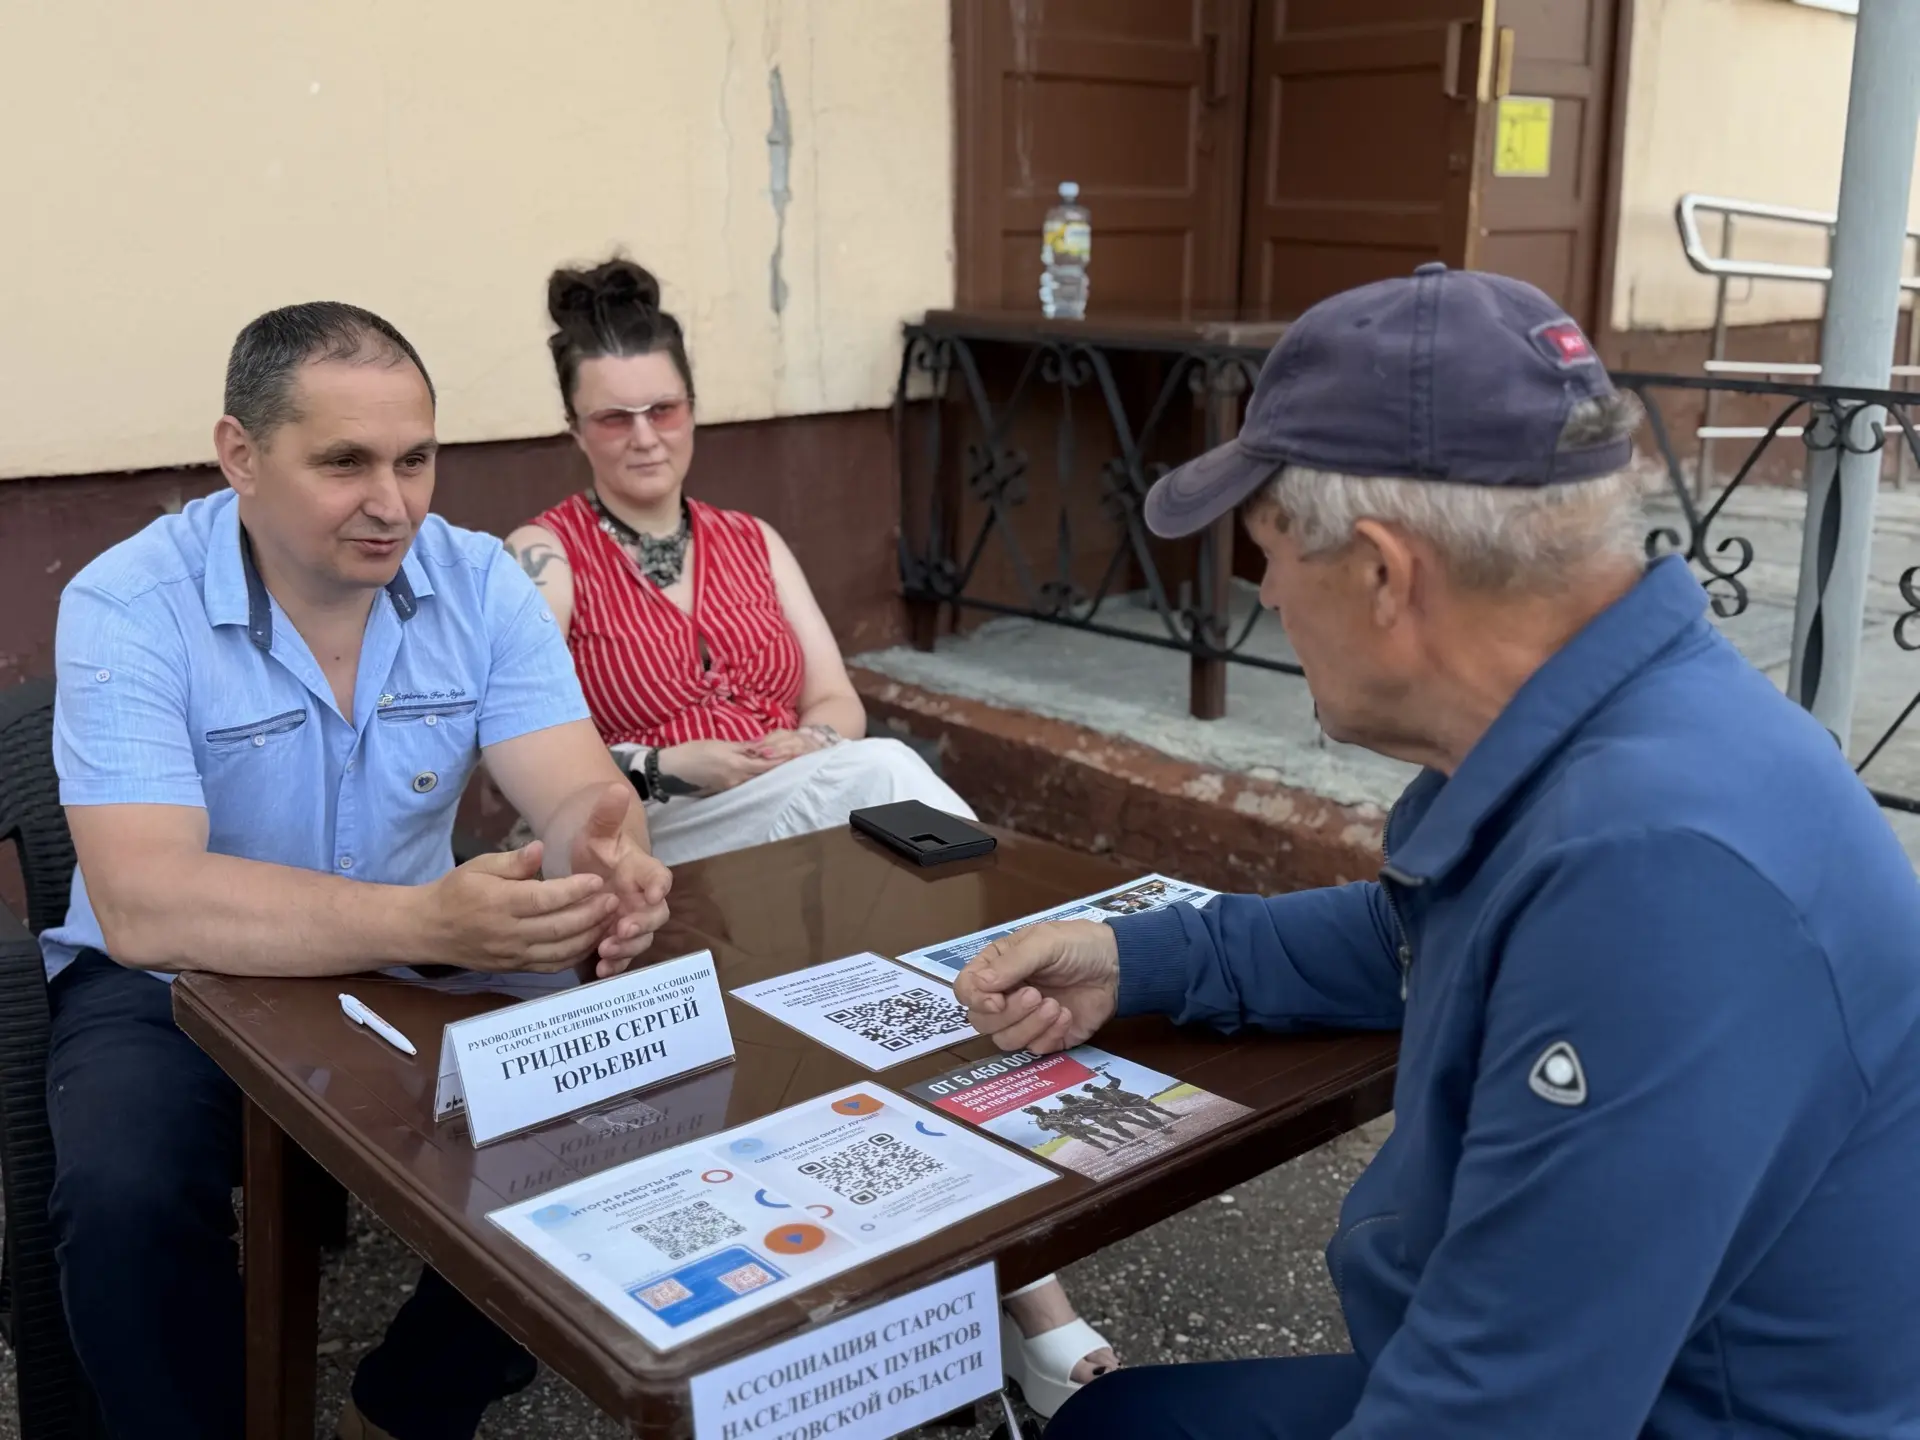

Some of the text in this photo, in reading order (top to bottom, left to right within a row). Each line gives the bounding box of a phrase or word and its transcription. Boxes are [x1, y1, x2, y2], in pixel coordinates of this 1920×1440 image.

[468, 968, 711, 1051] РУКОВОДИТЕЛЬ ПЕРВИЧНОГО ОТДЕЛА АССОЦИАЦИИ
[495, 985, 695, 1055] СТАРОСТ НАСЕЛЕННЫХ ПУНКТОВ ММО МО
[501, 996, 701, 1080] ГРИДНЕВ СЕРГЕЙ
[553, 1040, 668, 1094] ЮРЬЕВИЧ
[928, 1080, 956, 1095] ОТ
[954, 1075, 973, 1086] 5
[972, 1062, 1008, 1081] 450
[951, 1074, 1016, 1104] ПОЛАГАЕТСЯ
[1015, 1056, 1065, 1078] КАЖДОМУ
[961, 1074, 1040, 1108] КОНТРАКТНИКУ
[972, 1079, 1055, 1113] ЗА ПЕРВЫЙ ГОД
[754, 1145, 797, 1164] СДЕЛАЕМ
[798, 1136, 820, 1149] НАШ
[820, 1124, 846, 1139] ОКРУГ
[570, 1168, 693, 1217] ИТОГИ РАБОТЫ 2025
[602, 1181, 679, 1213] ПЛАНЫ 2026
[722, 1291, 976, 1411] АССОЦИАЦИЯ СТАРОСТ
[722, 1321, 982, 1440] НАСЕЛЕННЫХ ПУНКТОВ
[888, 1350, 984, 1406] ОБЛАСТИ
